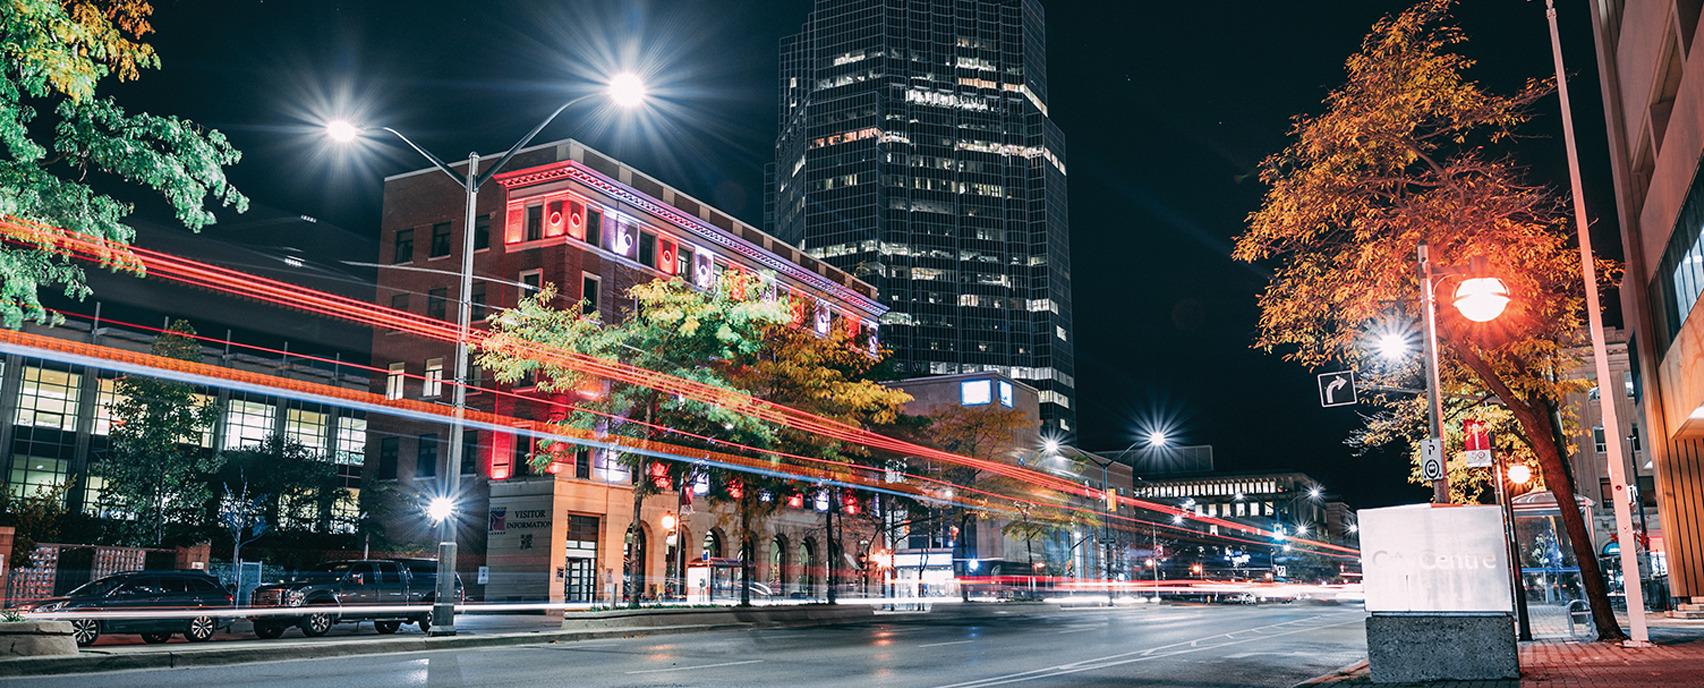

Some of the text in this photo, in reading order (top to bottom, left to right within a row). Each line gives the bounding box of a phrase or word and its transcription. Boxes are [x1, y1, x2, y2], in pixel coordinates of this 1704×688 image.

[514, 510, 546, 519] VISITOR
[506, 520, 553, 529] INFORMATION
[1420, 549, 1497, 570] Centre
